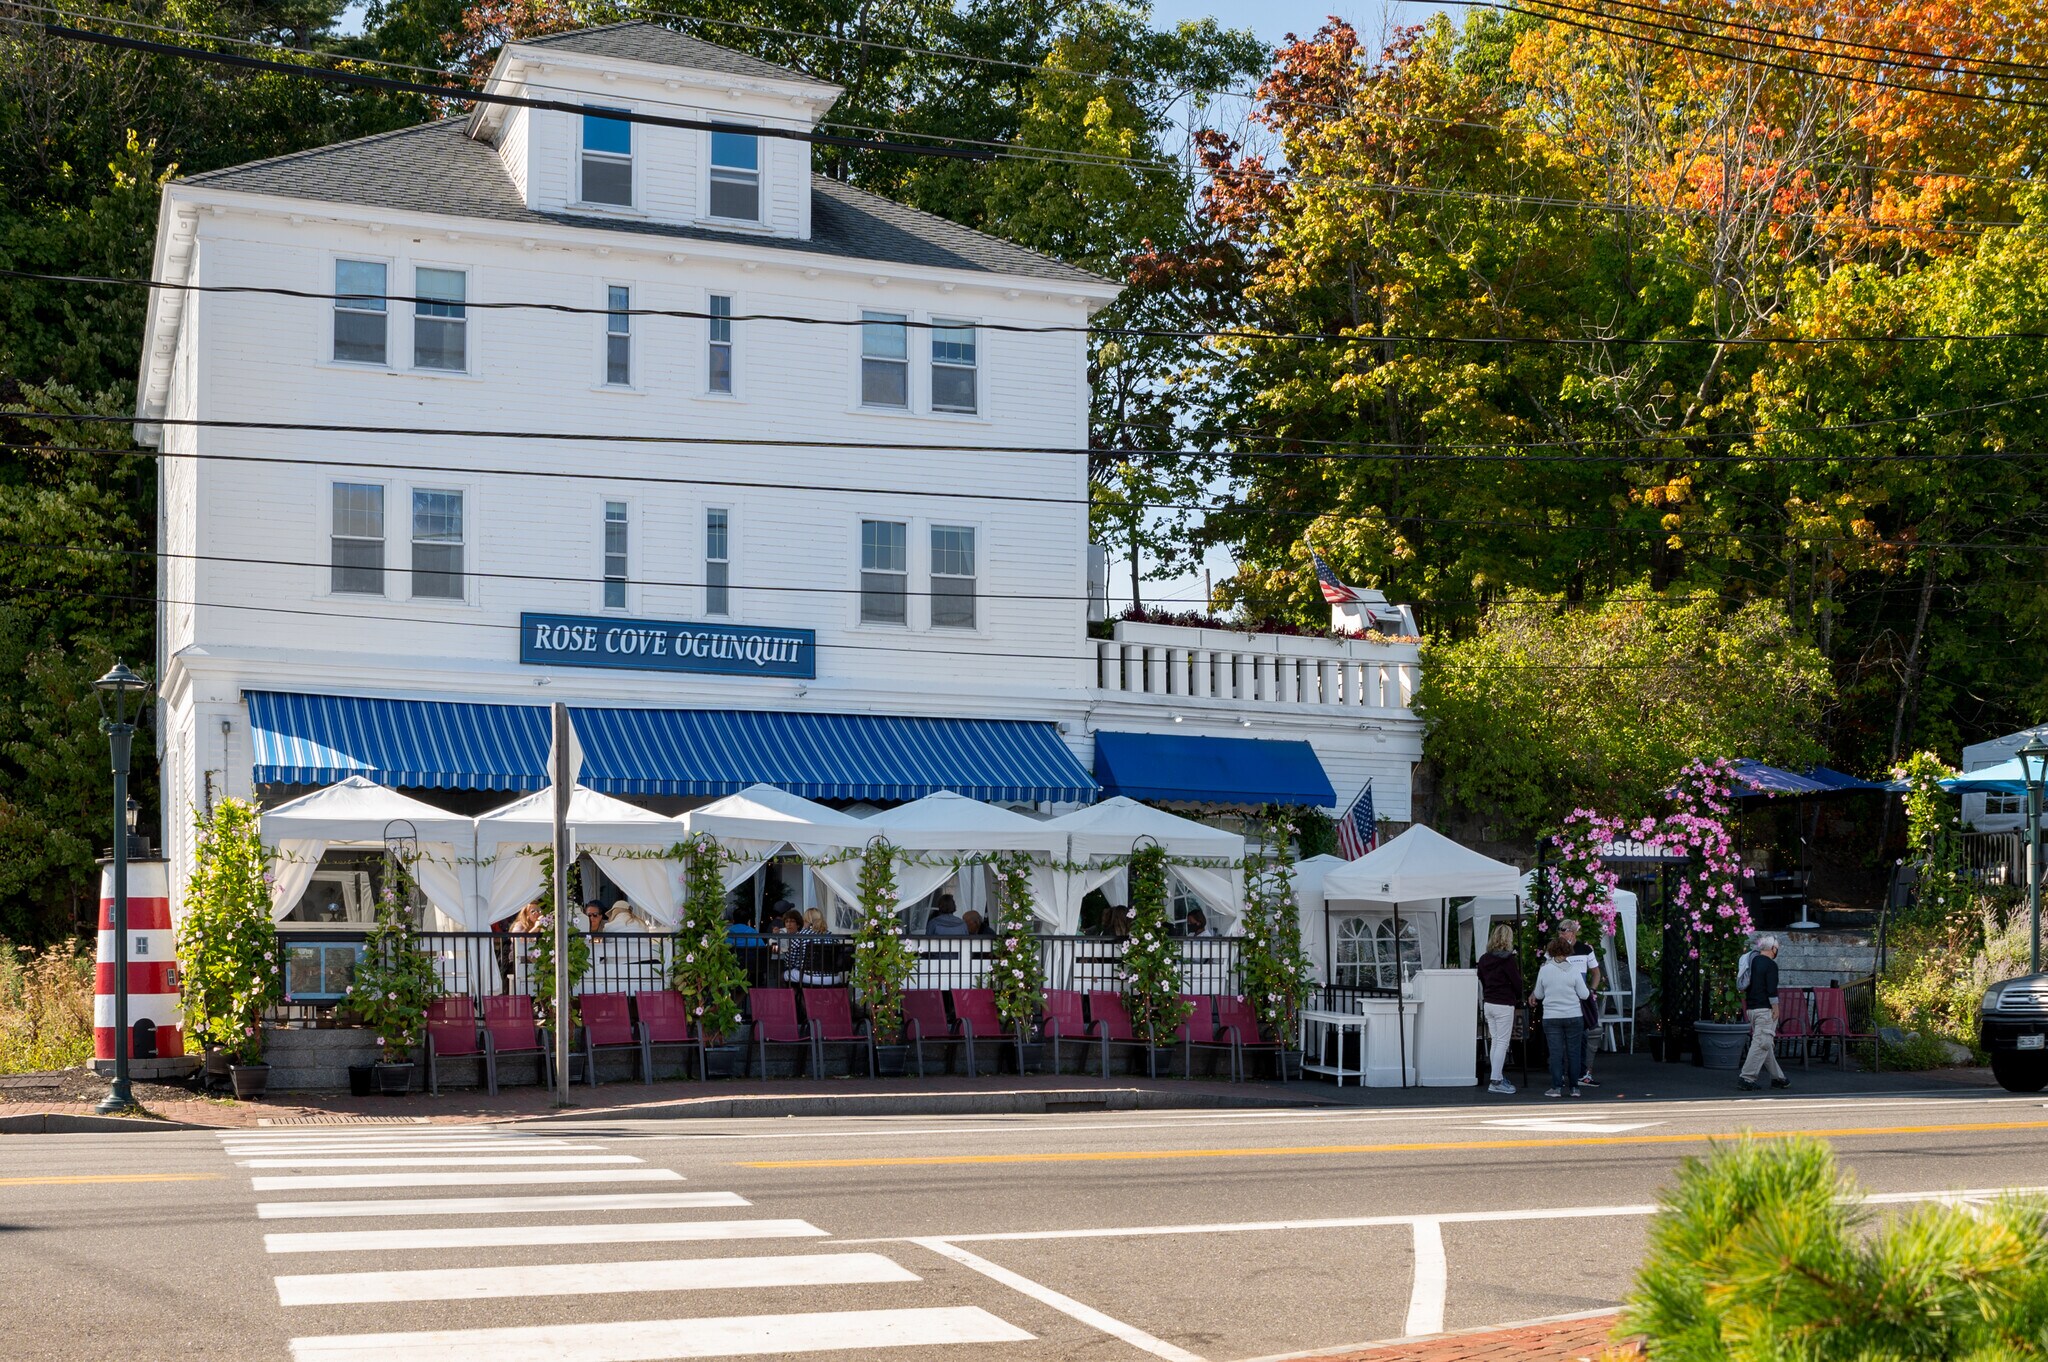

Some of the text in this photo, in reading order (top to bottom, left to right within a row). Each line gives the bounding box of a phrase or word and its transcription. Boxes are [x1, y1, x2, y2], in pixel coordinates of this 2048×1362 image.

[533, 623, 805, 667] ROSE COVE OGUNQUIT
